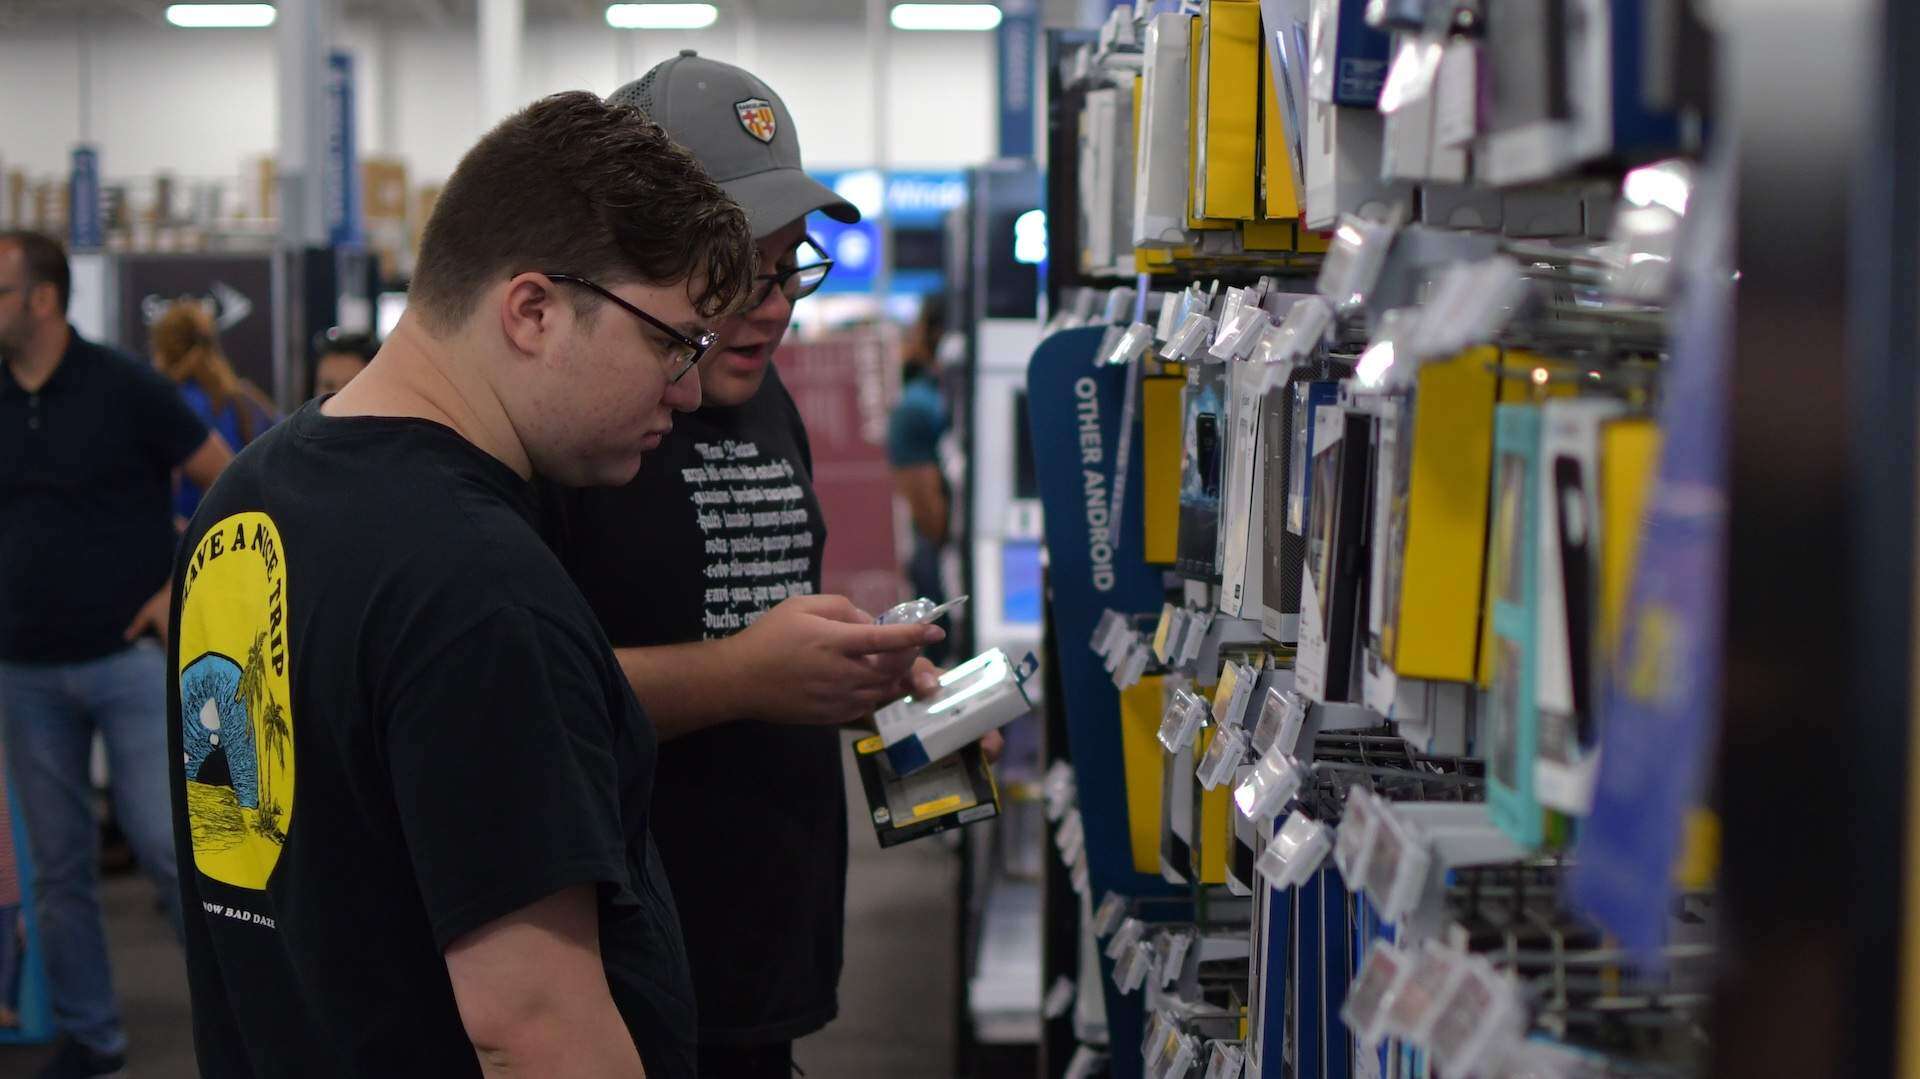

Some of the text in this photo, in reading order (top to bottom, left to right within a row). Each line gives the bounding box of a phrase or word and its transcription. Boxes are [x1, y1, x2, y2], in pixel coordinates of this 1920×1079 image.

[1074, 376, 1116, 591] OTHER ANDROID
[231, 523, 246, 552] A
[251, 523, 279, 582] NICE
[269, 582, 285, 677] TRIP
[225, 907, 252, 921] BAD
